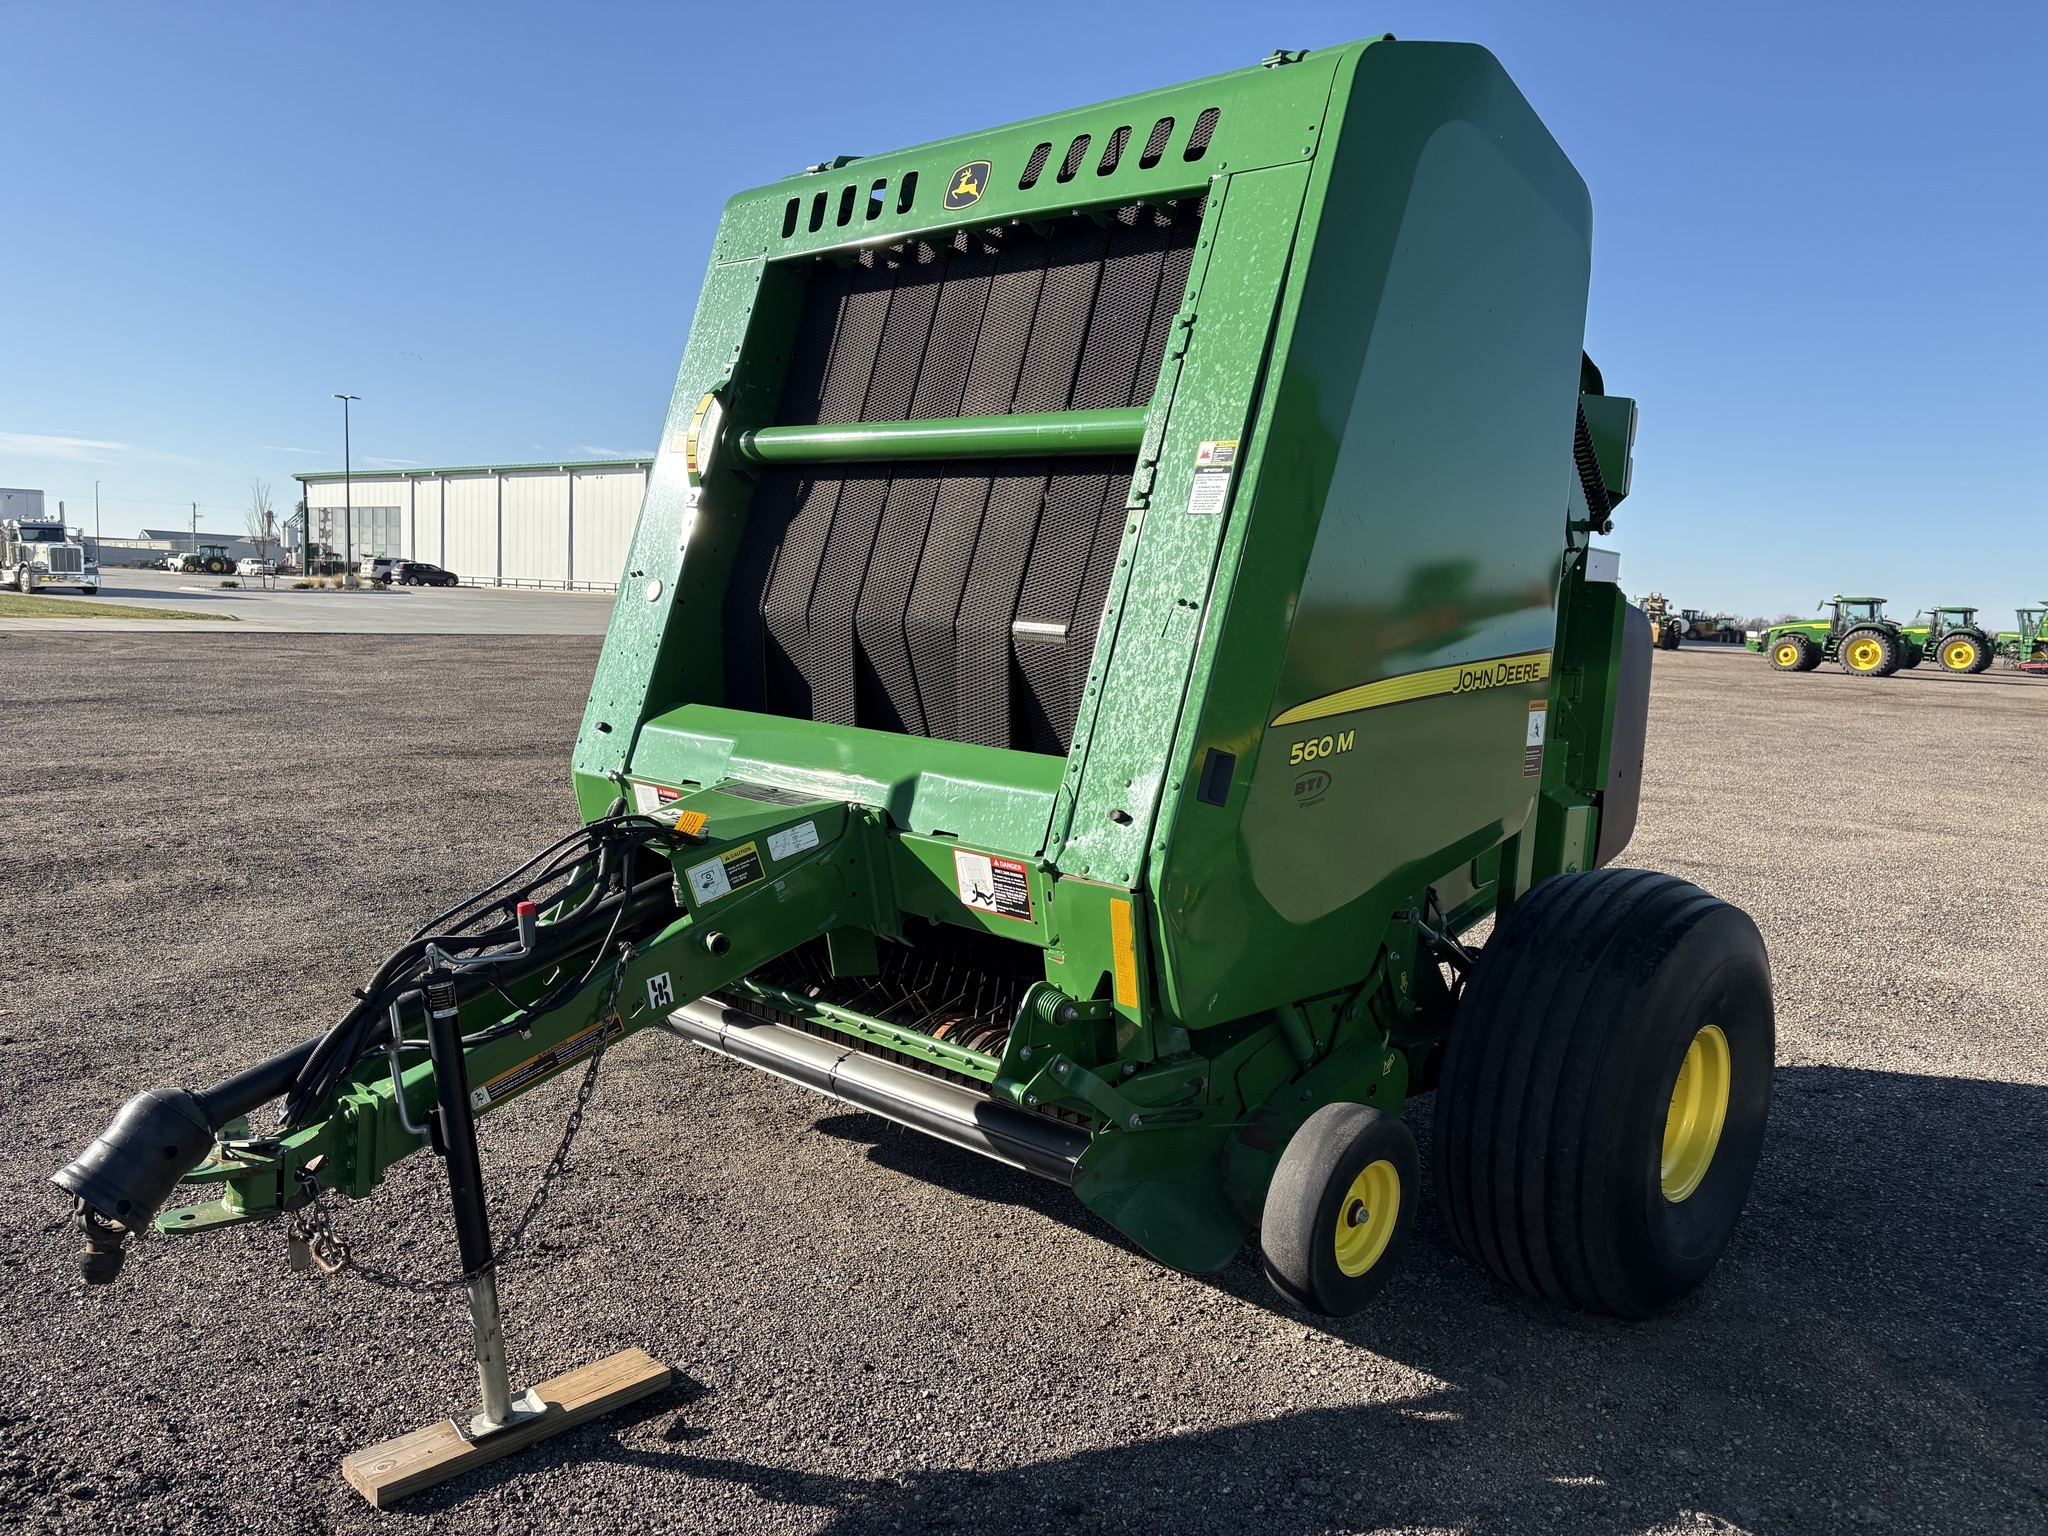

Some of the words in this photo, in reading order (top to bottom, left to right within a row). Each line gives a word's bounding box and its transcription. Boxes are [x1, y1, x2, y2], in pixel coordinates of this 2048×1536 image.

[1452, 668, 1494, 691] JOHN
[1495, 663, 1541, 684] DEERE
[1289, 734, 1334, 766] 560
[1336, 728, 1356, 755] M
[1294, 776, 1324, 796] BTI
[730, 846, 752, 859] CAUTION
[1000, 861, 1022, 870] DANGER
[541, 1041, 568, 1057] WARNING
